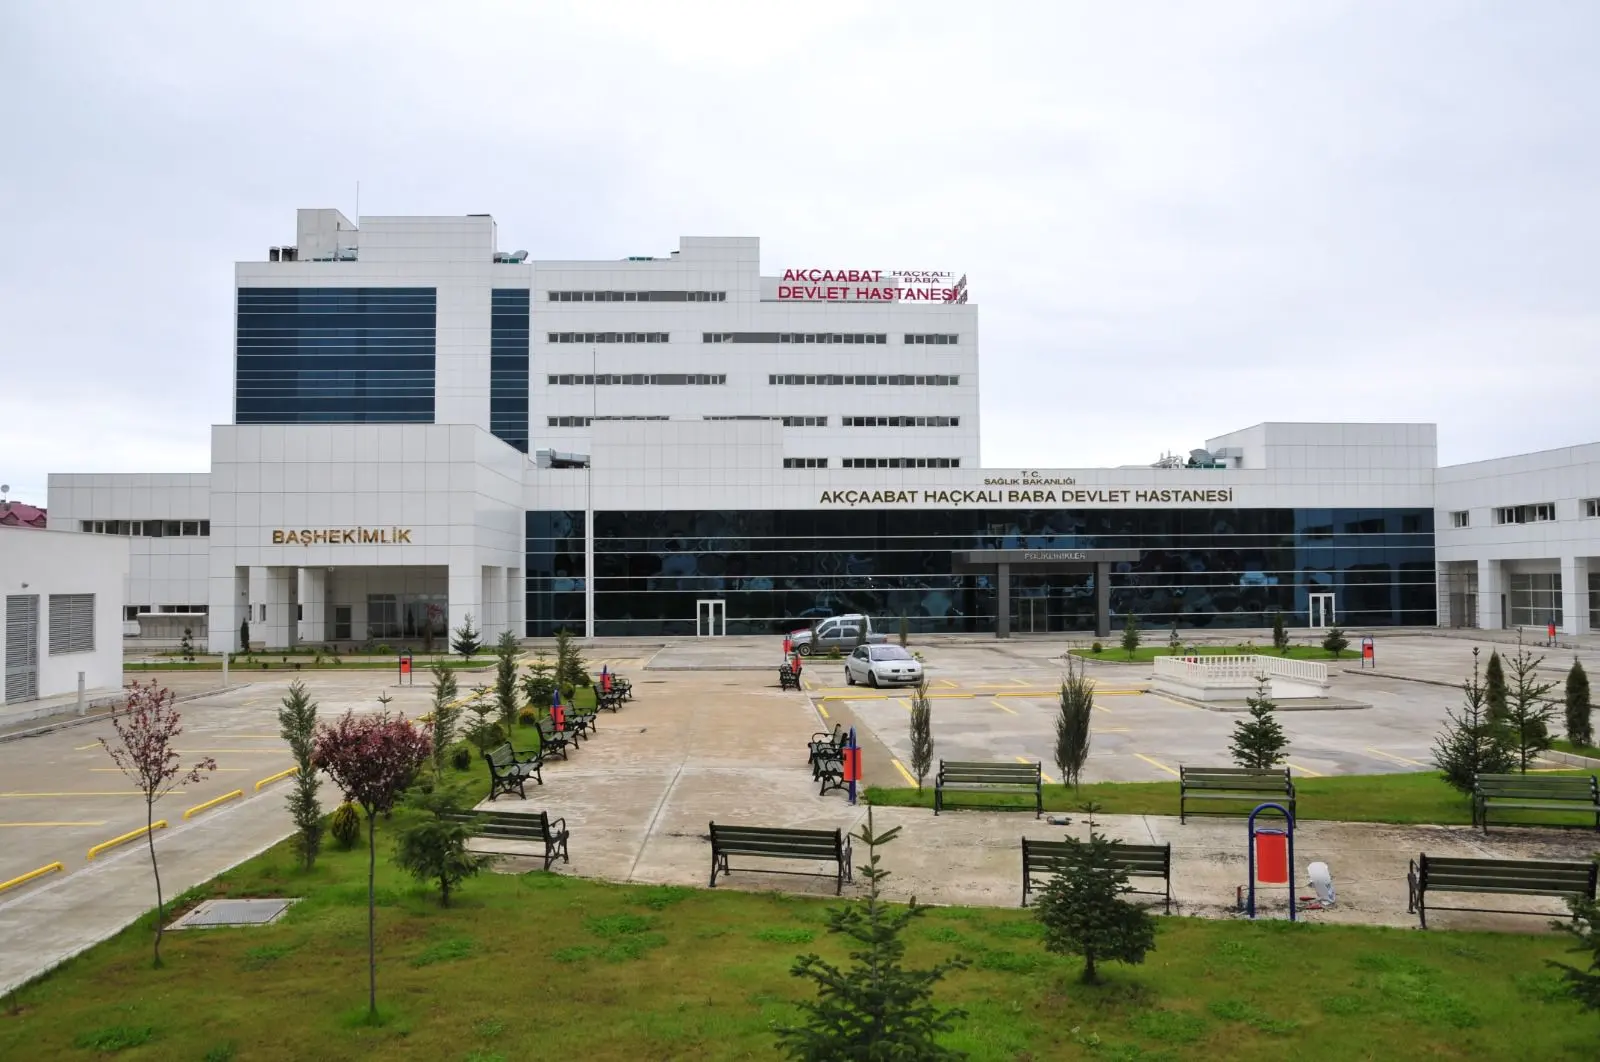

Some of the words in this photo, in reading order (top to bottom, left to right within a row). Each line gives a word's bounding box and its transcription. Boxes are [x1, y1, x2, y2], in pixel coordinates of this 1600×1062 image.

[783, 269, 882, 284] AKÇAABAT
[778, 286, 850, 299] DEVLET
[984, 477, 1019, 486] SAĞLIK
[1022, 477, 1076, 486] BAKANLIĞI
[820, 490, 918, 506] AKÇAABAT
[924, 490, 1002, 506] HAÇKALI
[1008, 490, 1056, 502] BABA
[1062, 490, 1130, 502] DEVLET
[1136, 487, 1232, 502] HASTANESİ
[272, 526, 412, 547] BAŞHEKİMLİK
